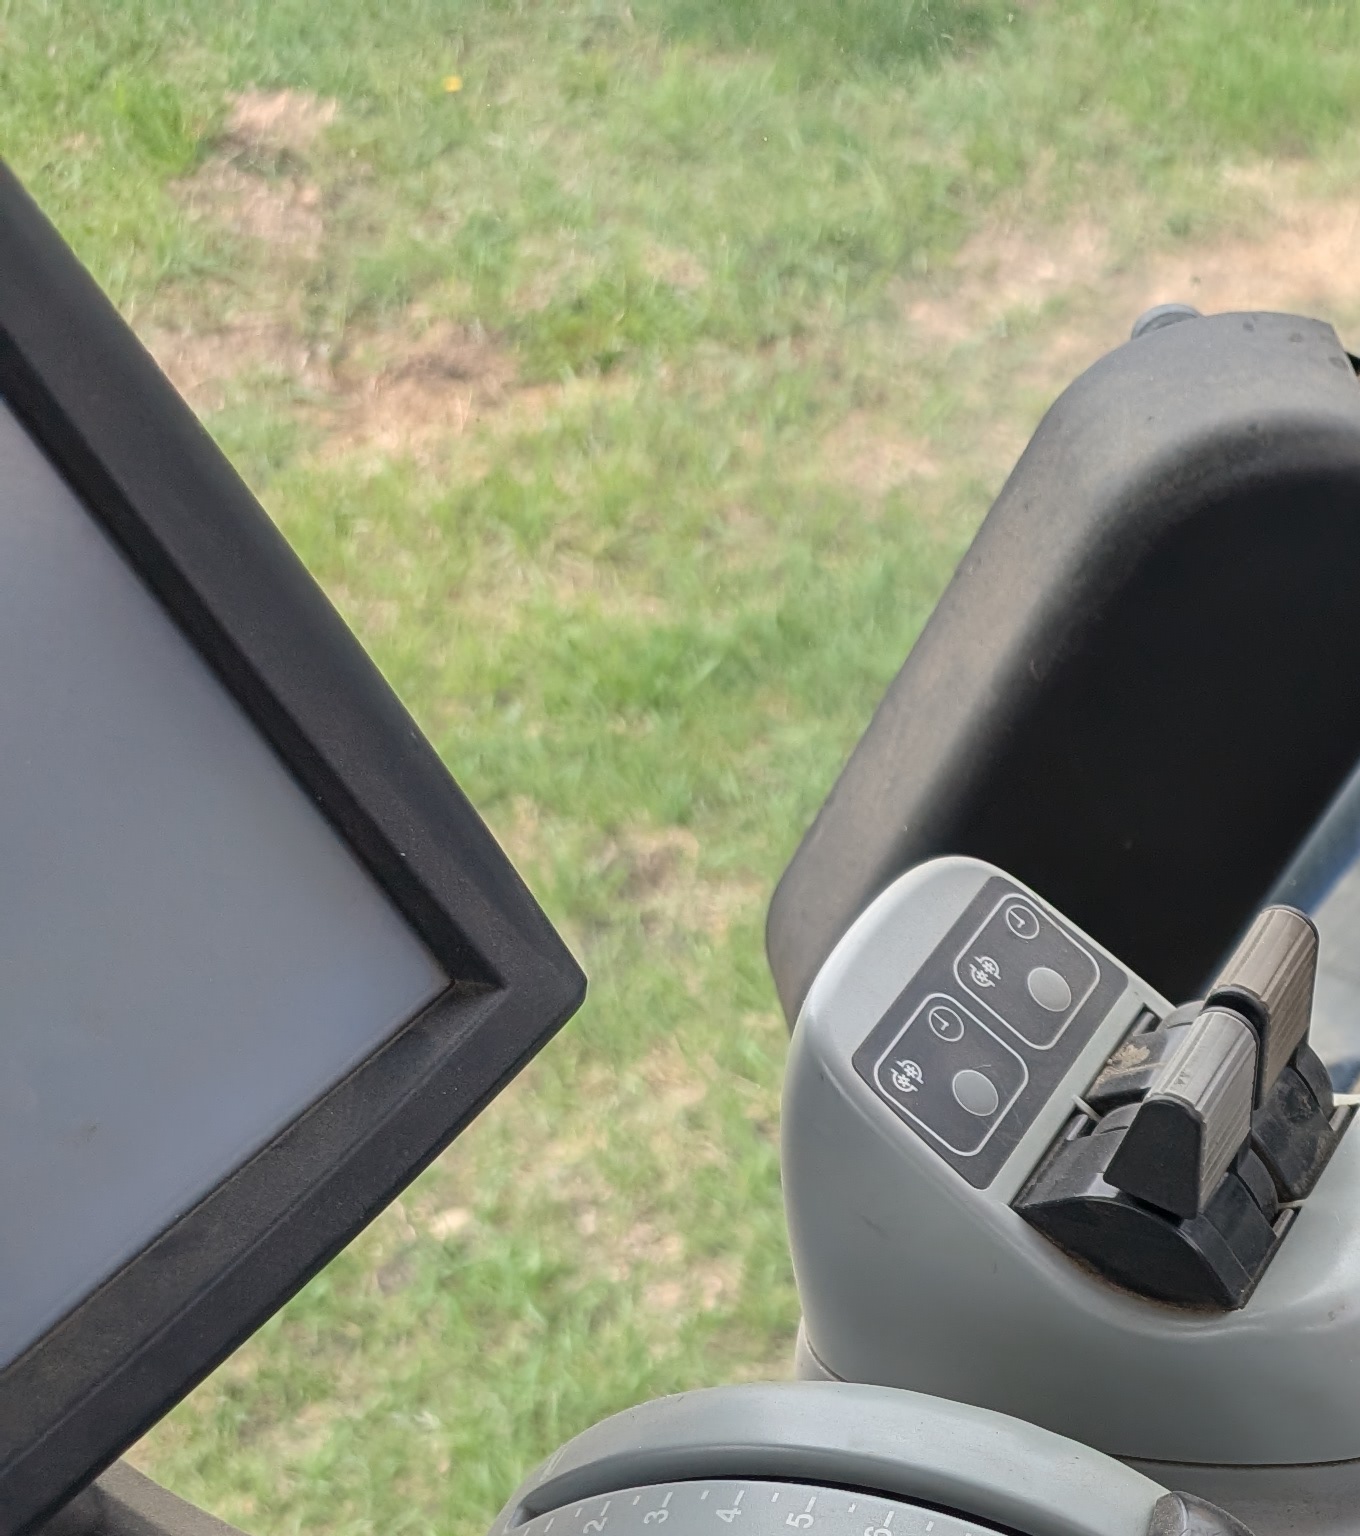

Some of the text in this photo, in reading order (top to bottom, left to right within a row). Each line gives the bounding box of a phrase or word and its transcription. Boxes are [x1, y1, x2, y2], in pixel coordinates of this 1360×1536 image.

[582, 1517, 608, 1534] 2
[643, 1509, 669, 1525] 3
[715, 1507, 742, 1523] 4
[785, 1512, 814, 1529] 5
